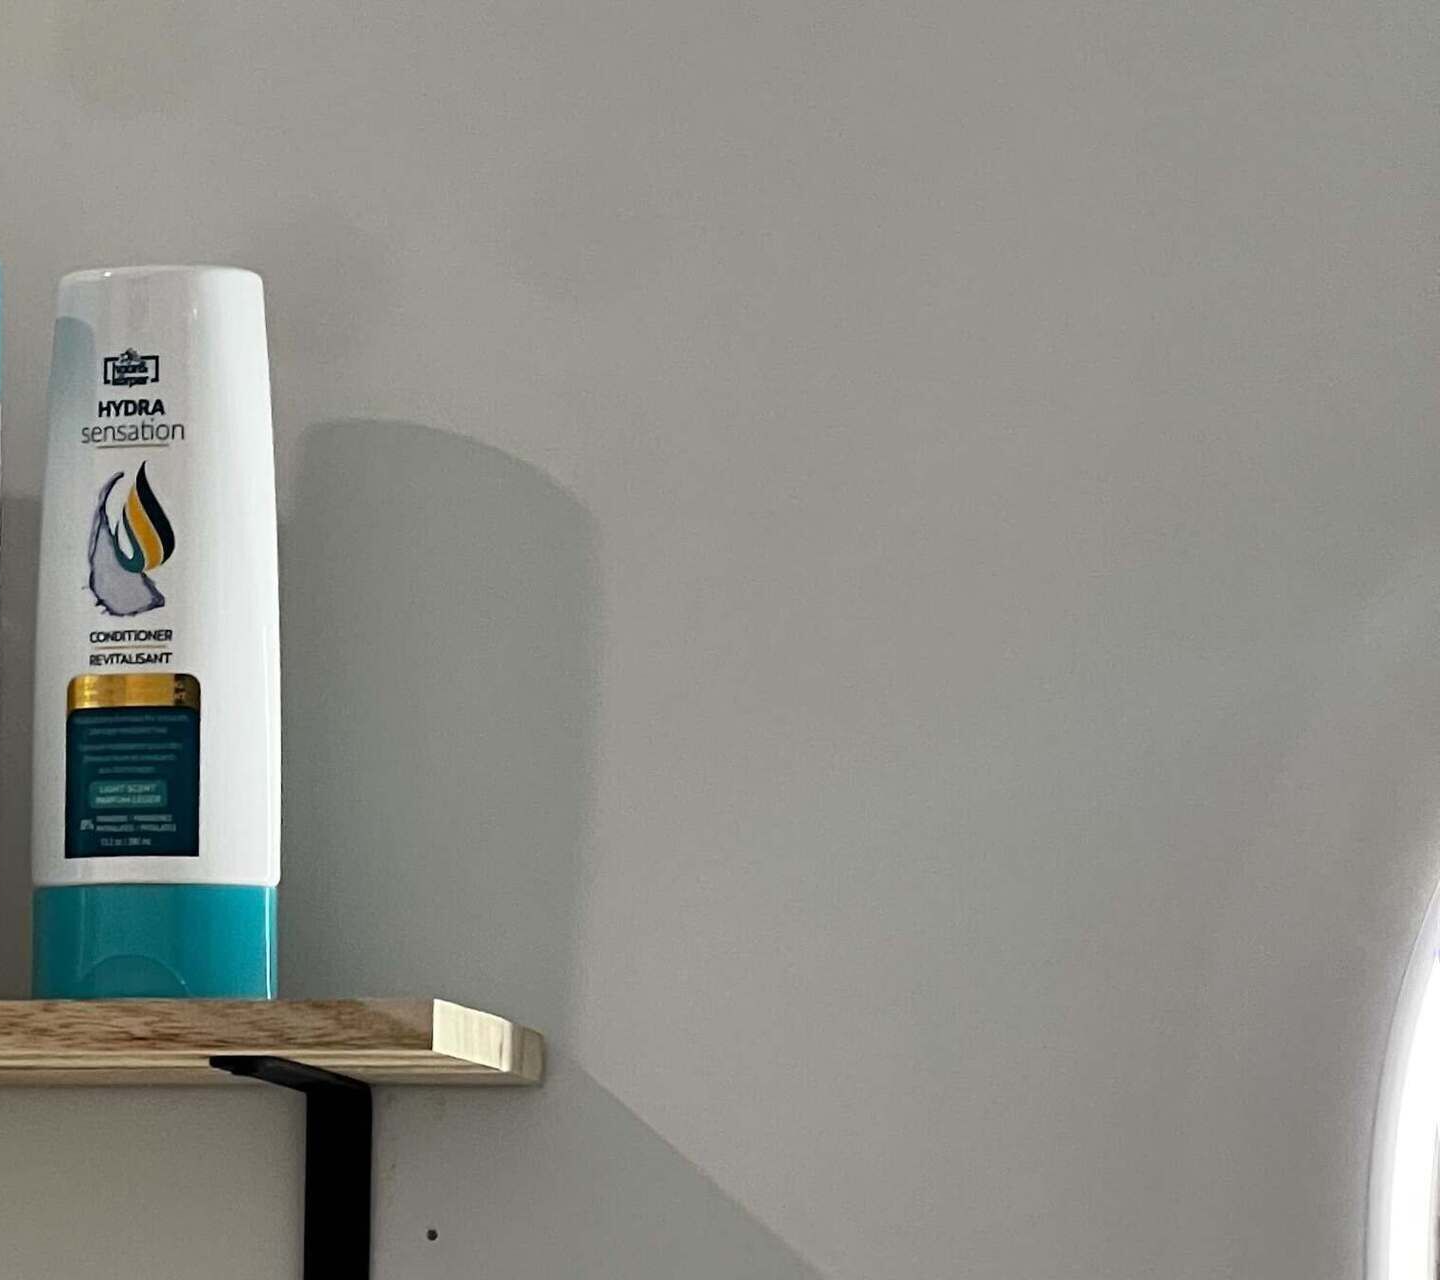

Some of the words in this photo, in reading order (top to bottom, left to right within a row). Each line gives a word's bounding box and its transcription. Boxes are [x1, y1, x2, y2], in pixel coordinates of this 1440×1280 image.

[98, 399, 166, 418] HYDRA
[81, 418, 185, 444] sensation
[89, 630, 173, 643] CONDITIONER
[89, 652, 173, 666] REVITALISANT
